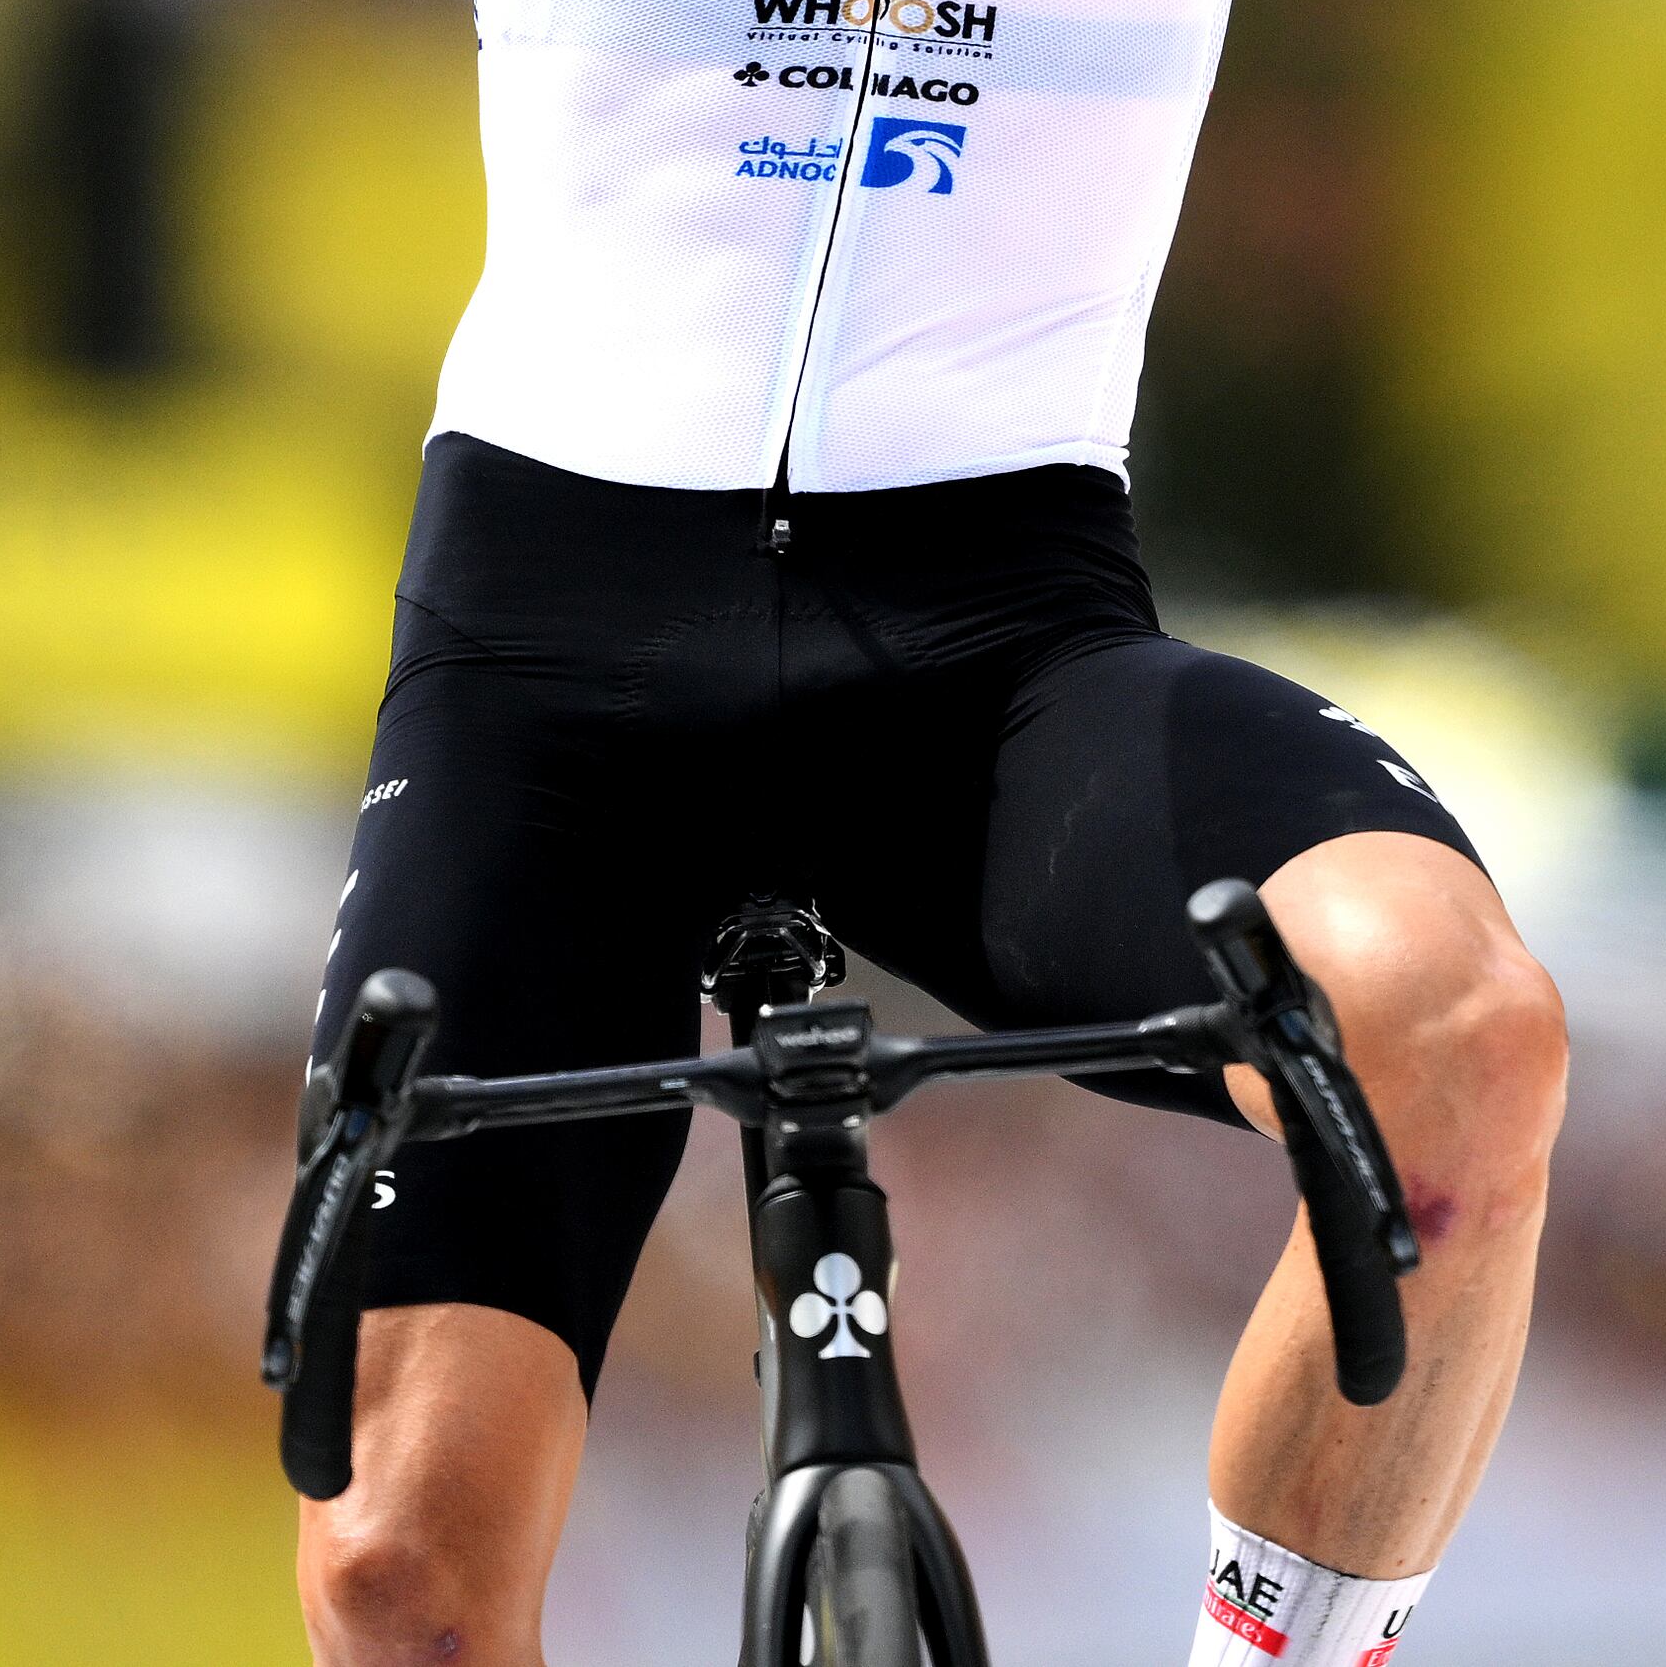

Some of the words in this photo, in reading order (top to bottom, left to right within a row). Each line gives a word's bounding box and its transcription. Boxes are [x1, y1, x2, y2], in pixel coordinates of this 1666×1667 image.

[747, 31, 820, 41] Virtual
[912, 42, 993, 60] Solution
[778, 65, 980, 106] COLNAGO
[735, 159, 837, 182] ADNOC
[1209, 1548, 1285, 1618] AE
